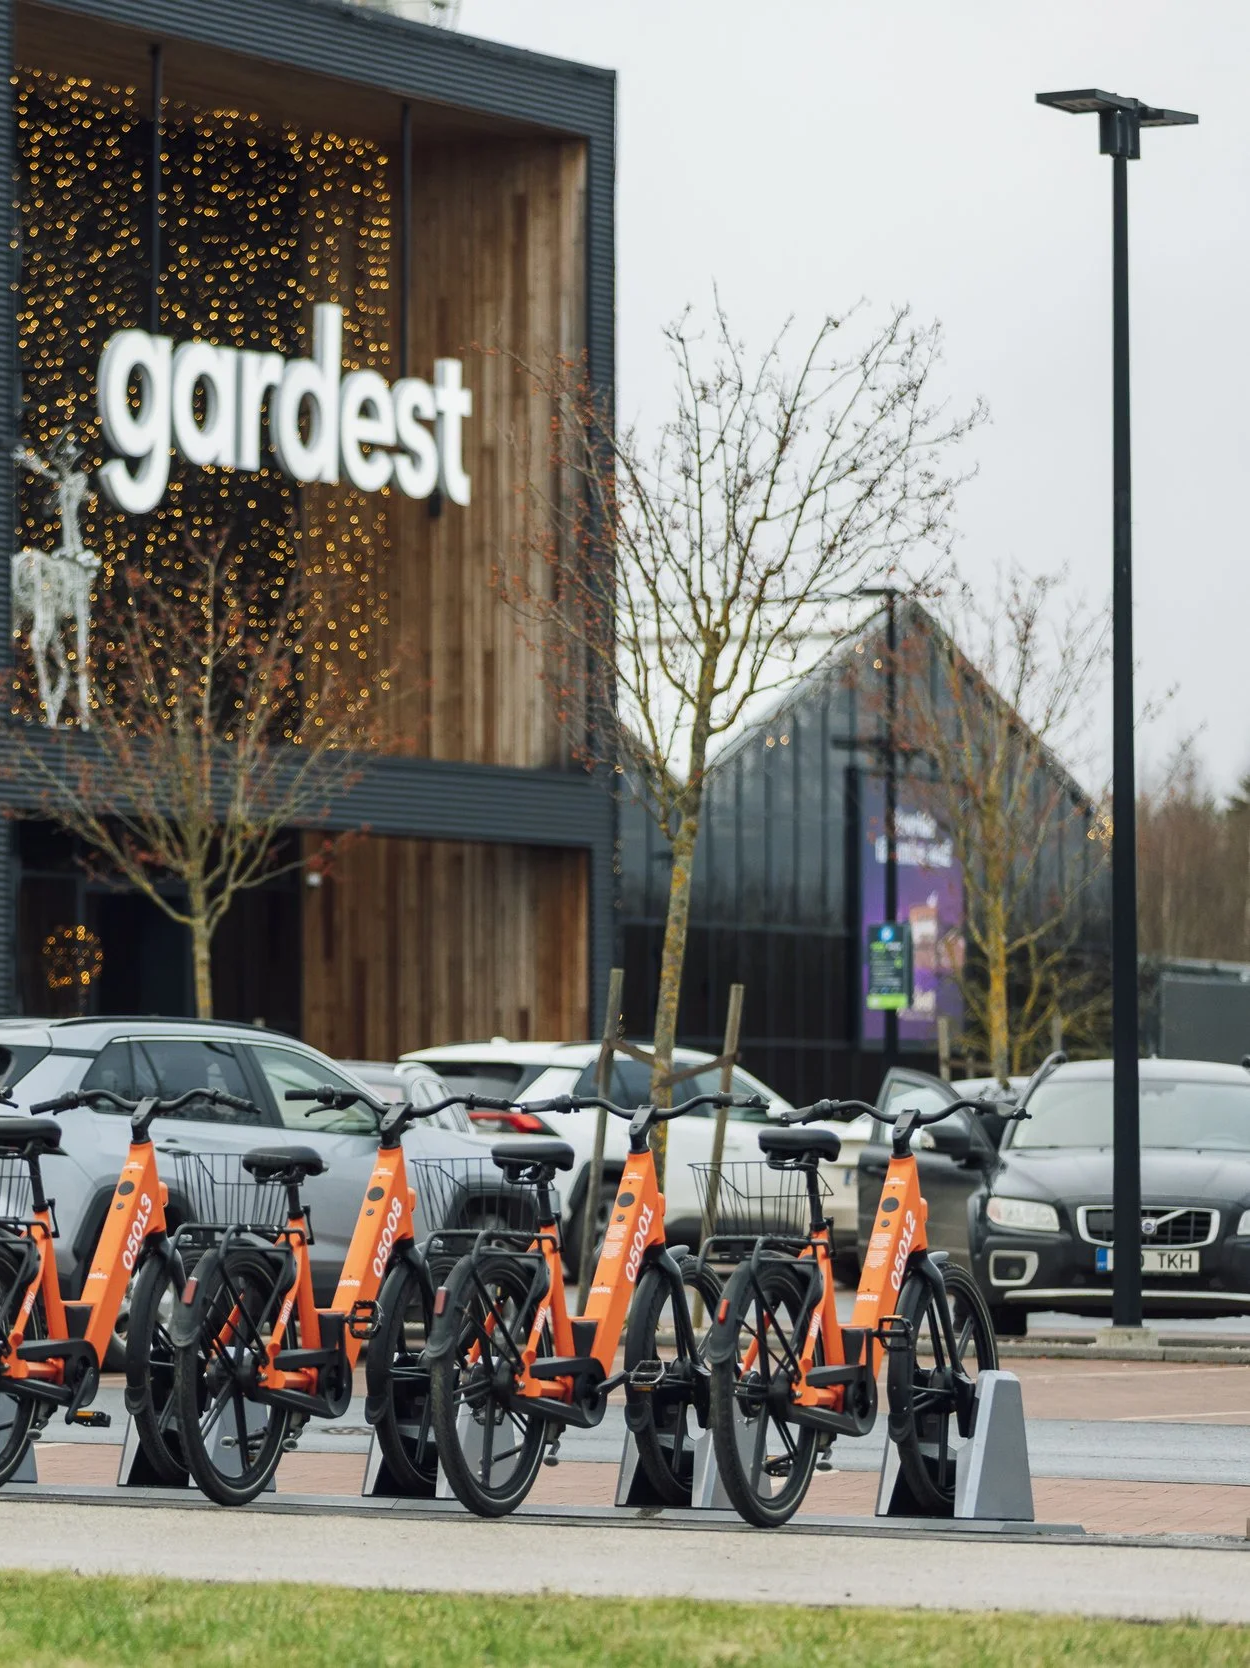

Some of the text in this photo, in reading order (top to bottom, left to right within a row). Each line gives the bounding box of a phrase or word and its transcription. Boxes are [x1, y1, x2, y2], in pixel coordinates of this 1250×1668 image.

[97, 302, 473, 515] gardest
[122, 1193, 152, 1270] 05013
[373, 1197, 402, 1278] 05008
[625, 1203, 653, 1282] 05001
[891, 1210, 917, 1292] 05012
[1157, 1252, 1192, 1269] TKH
